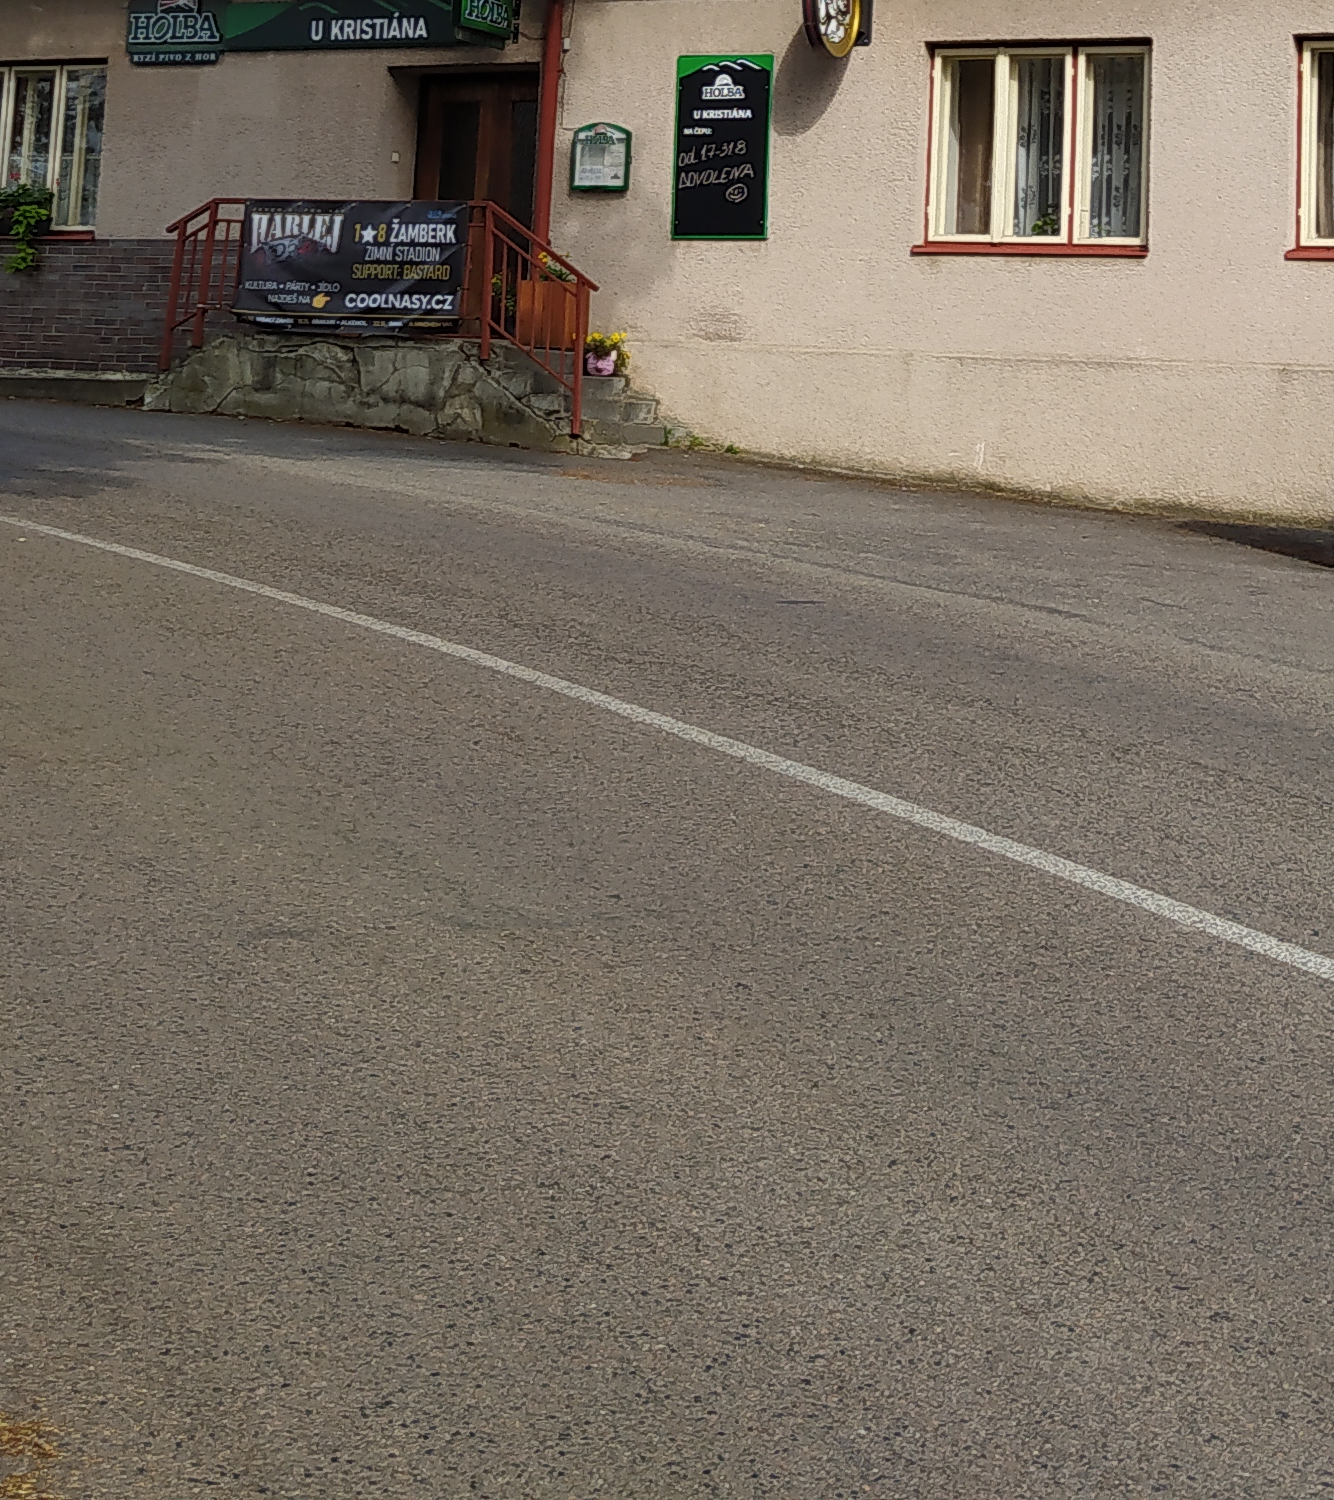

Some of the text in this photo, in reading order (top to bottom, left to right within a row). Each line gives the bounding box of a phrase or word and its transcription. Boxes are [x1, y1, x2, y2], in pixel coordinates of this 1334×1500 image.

[128, 12, 220, 43] HOLBA
[311, 12, 428, 41] U KRISTIÁNA
[702, 86, 745, 99] HOLBA
[693, 107, 752, 119] U KRISTIÁNA
[250, 211, 345, 254] HARLEJ
[389, 217, 457, 243] ŽAMBERK
[364, 243, 441, 262] ZIMNÍ STADION
[352, 263, 450, 280] SUPPORT: BASTARD
[345, 293, 454, 310] COOLNASY.CZ
